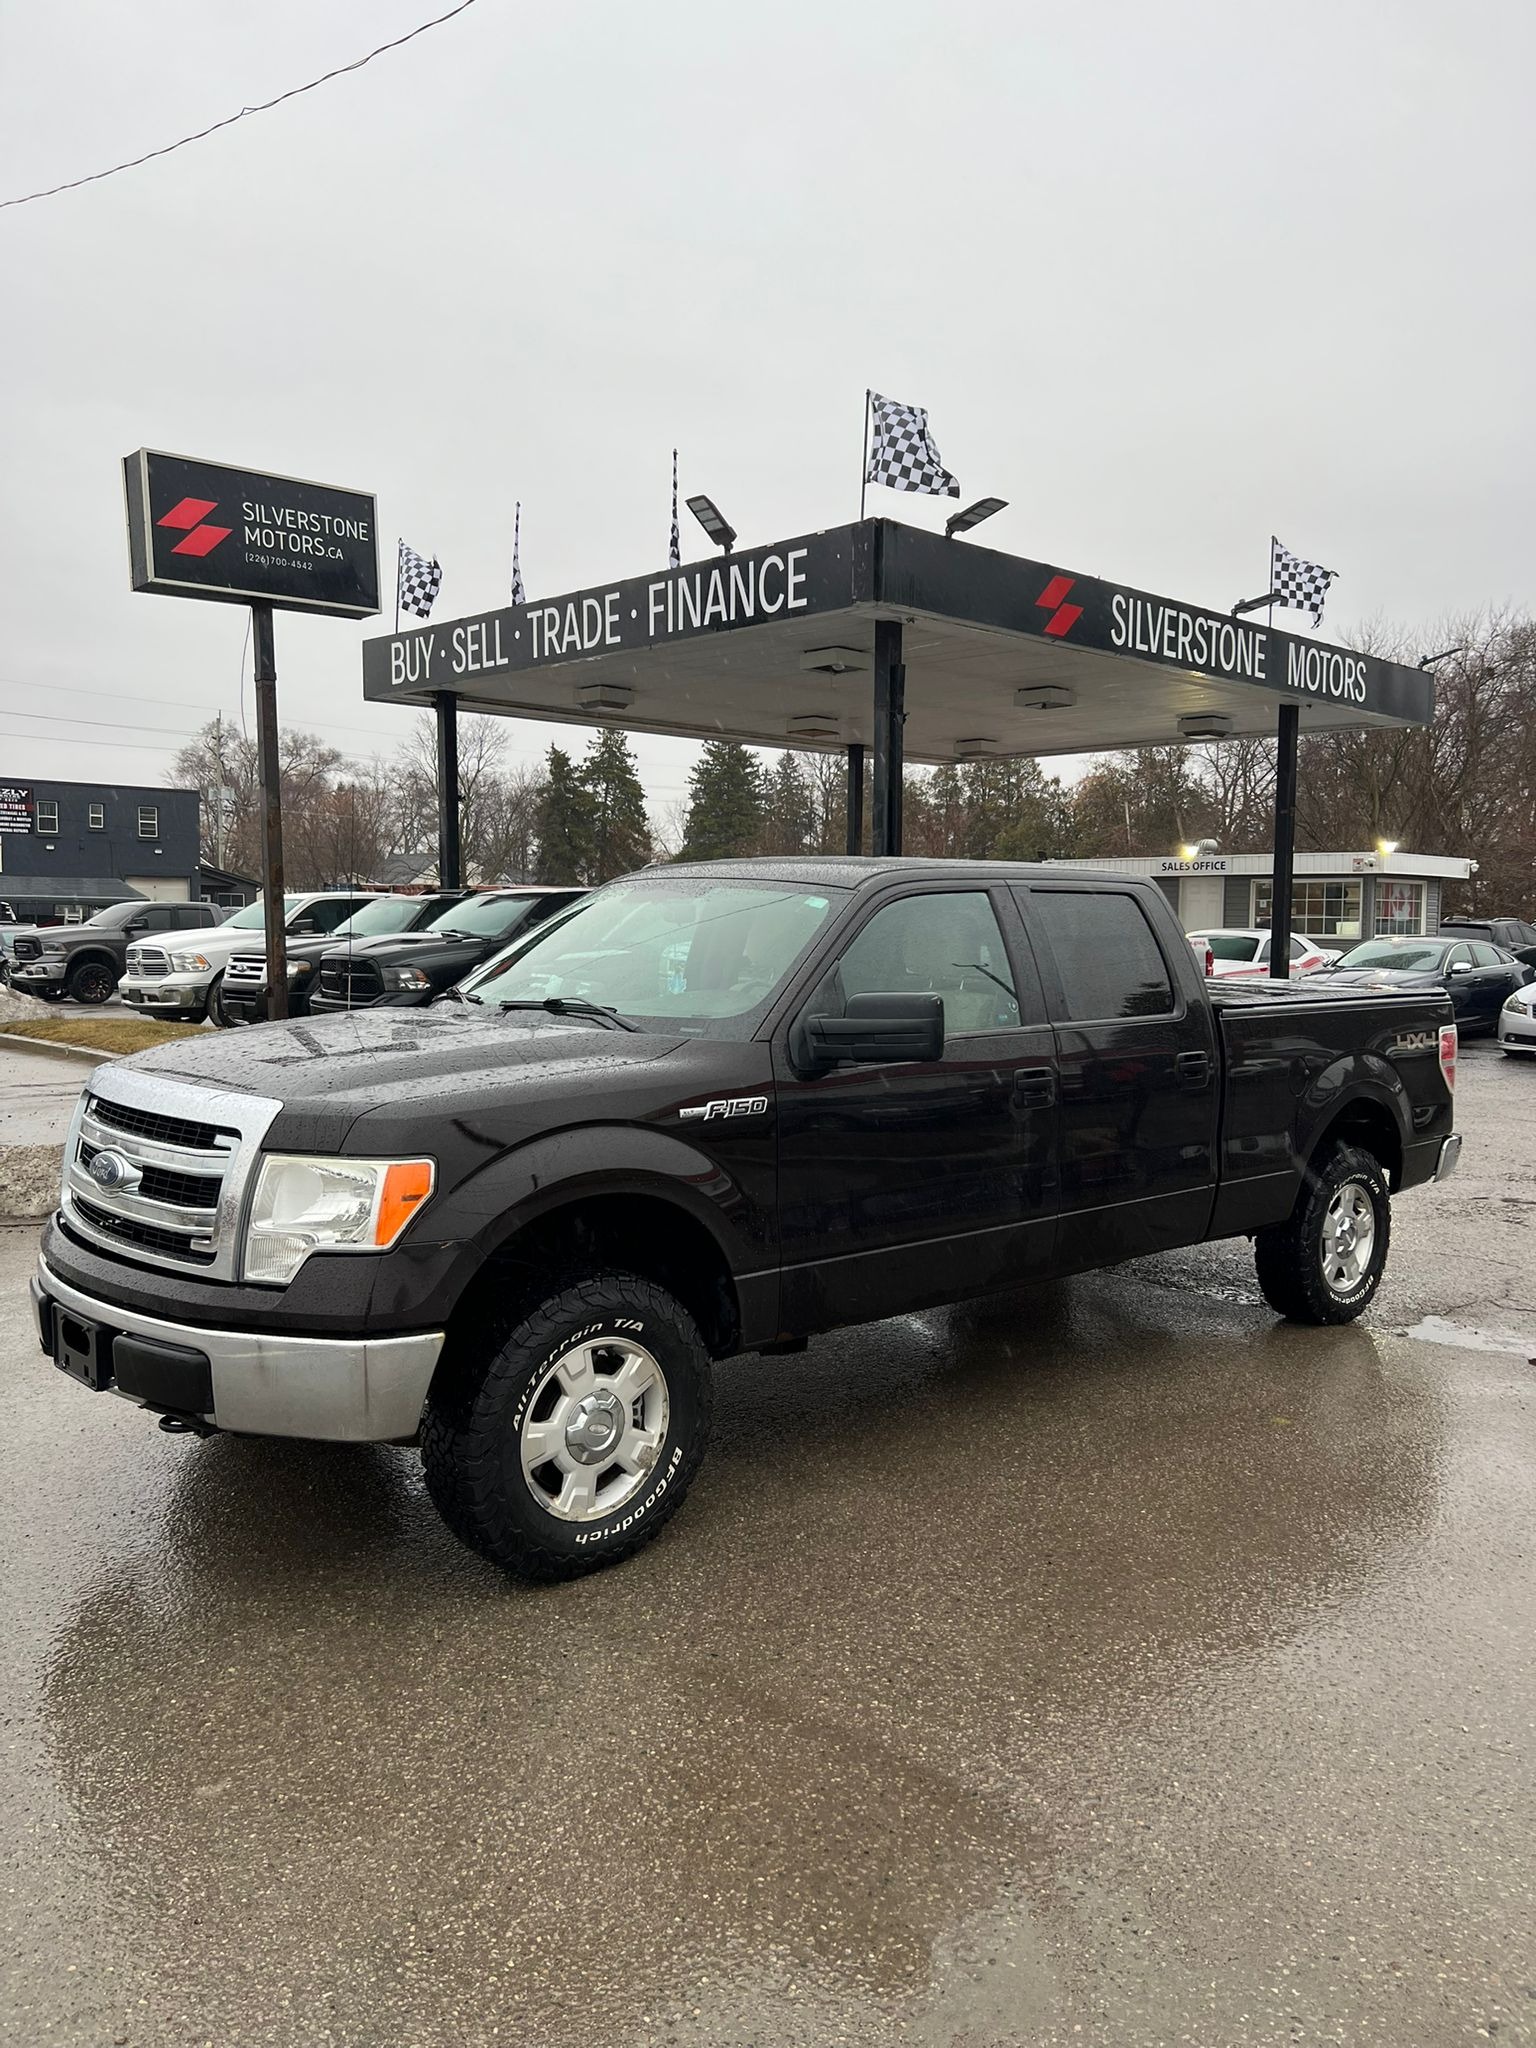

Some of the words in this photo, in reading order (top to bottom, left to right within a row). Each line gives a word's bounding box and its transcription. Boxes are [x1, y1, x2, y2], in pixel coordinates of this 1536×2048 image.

[242, 502, 369, 541] SILVERSTONE
[245, 526, 344, 560] MOTORS.CA
[391, 634, 435, 685] BUY
[452, 620, 509, 674] SELL
[527, 592, 621, 658] TRADE
[648, 548, 808, 637] FINANCE
[1110, 594, 1267, 680] SILVERSTONE
[1287, 641, 1366, 703] MOTORS
[0, 788, 28, 798] ZLY
[1161, 862, 1191, 871] SALES
[1192, 861, 1226, 871] OFFICE
[92, 1157, 112, 1180] Ford
[512, 1322, 603, 1431] All-Terrain
[614, 1318, 644, 1332] T/A
[575, 1446, 683, 1545] BFGoodrich
